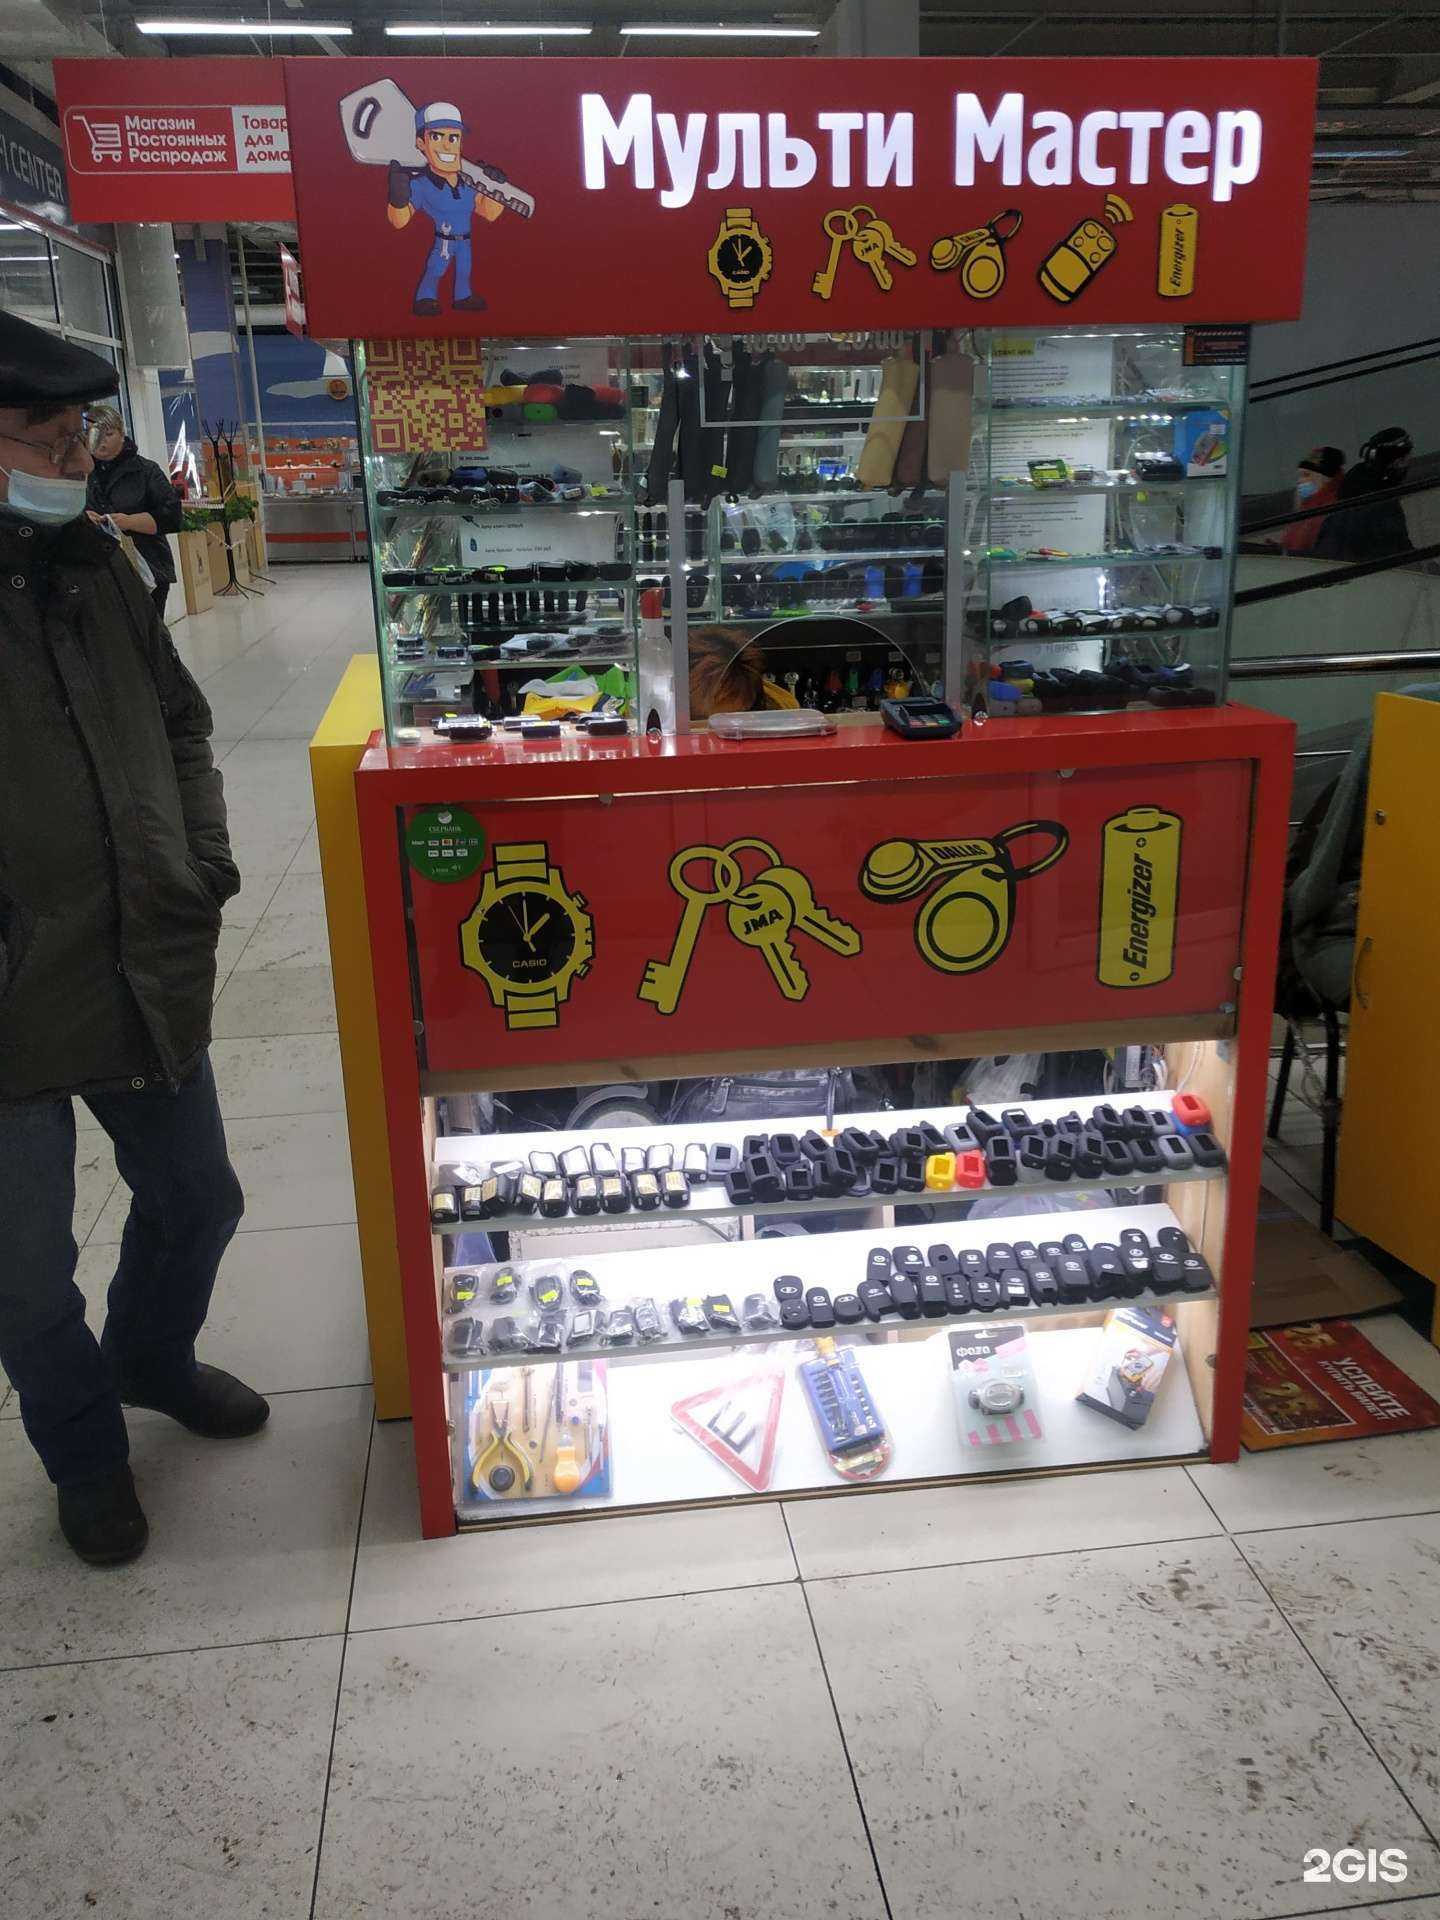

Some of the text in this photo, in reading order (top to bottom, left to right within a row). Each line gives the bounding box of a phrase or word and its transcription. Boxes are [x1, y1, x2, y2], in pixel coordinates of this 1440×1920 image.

[125, 115, 196, 131] Магазин
[127, 131, 227, 147] Постоянных
[244, 134, 274, 148] для
[129, 148, 228, 165] Распродаж
[581, 92, 1263, 209] Мульти Мастер
[10, 141, 64, 203] CENTER
[1169, 227, 1187, 288] Energizer
[929, 844, 988, 860] DALLAS
[743, 908, 784, 936] JMA
[1122, 852, 1157, 970] Energizer
[512, 958, 547, 968] CASIO
[1332, 1356, 1412, 1418] УСПЕЙТЕ
